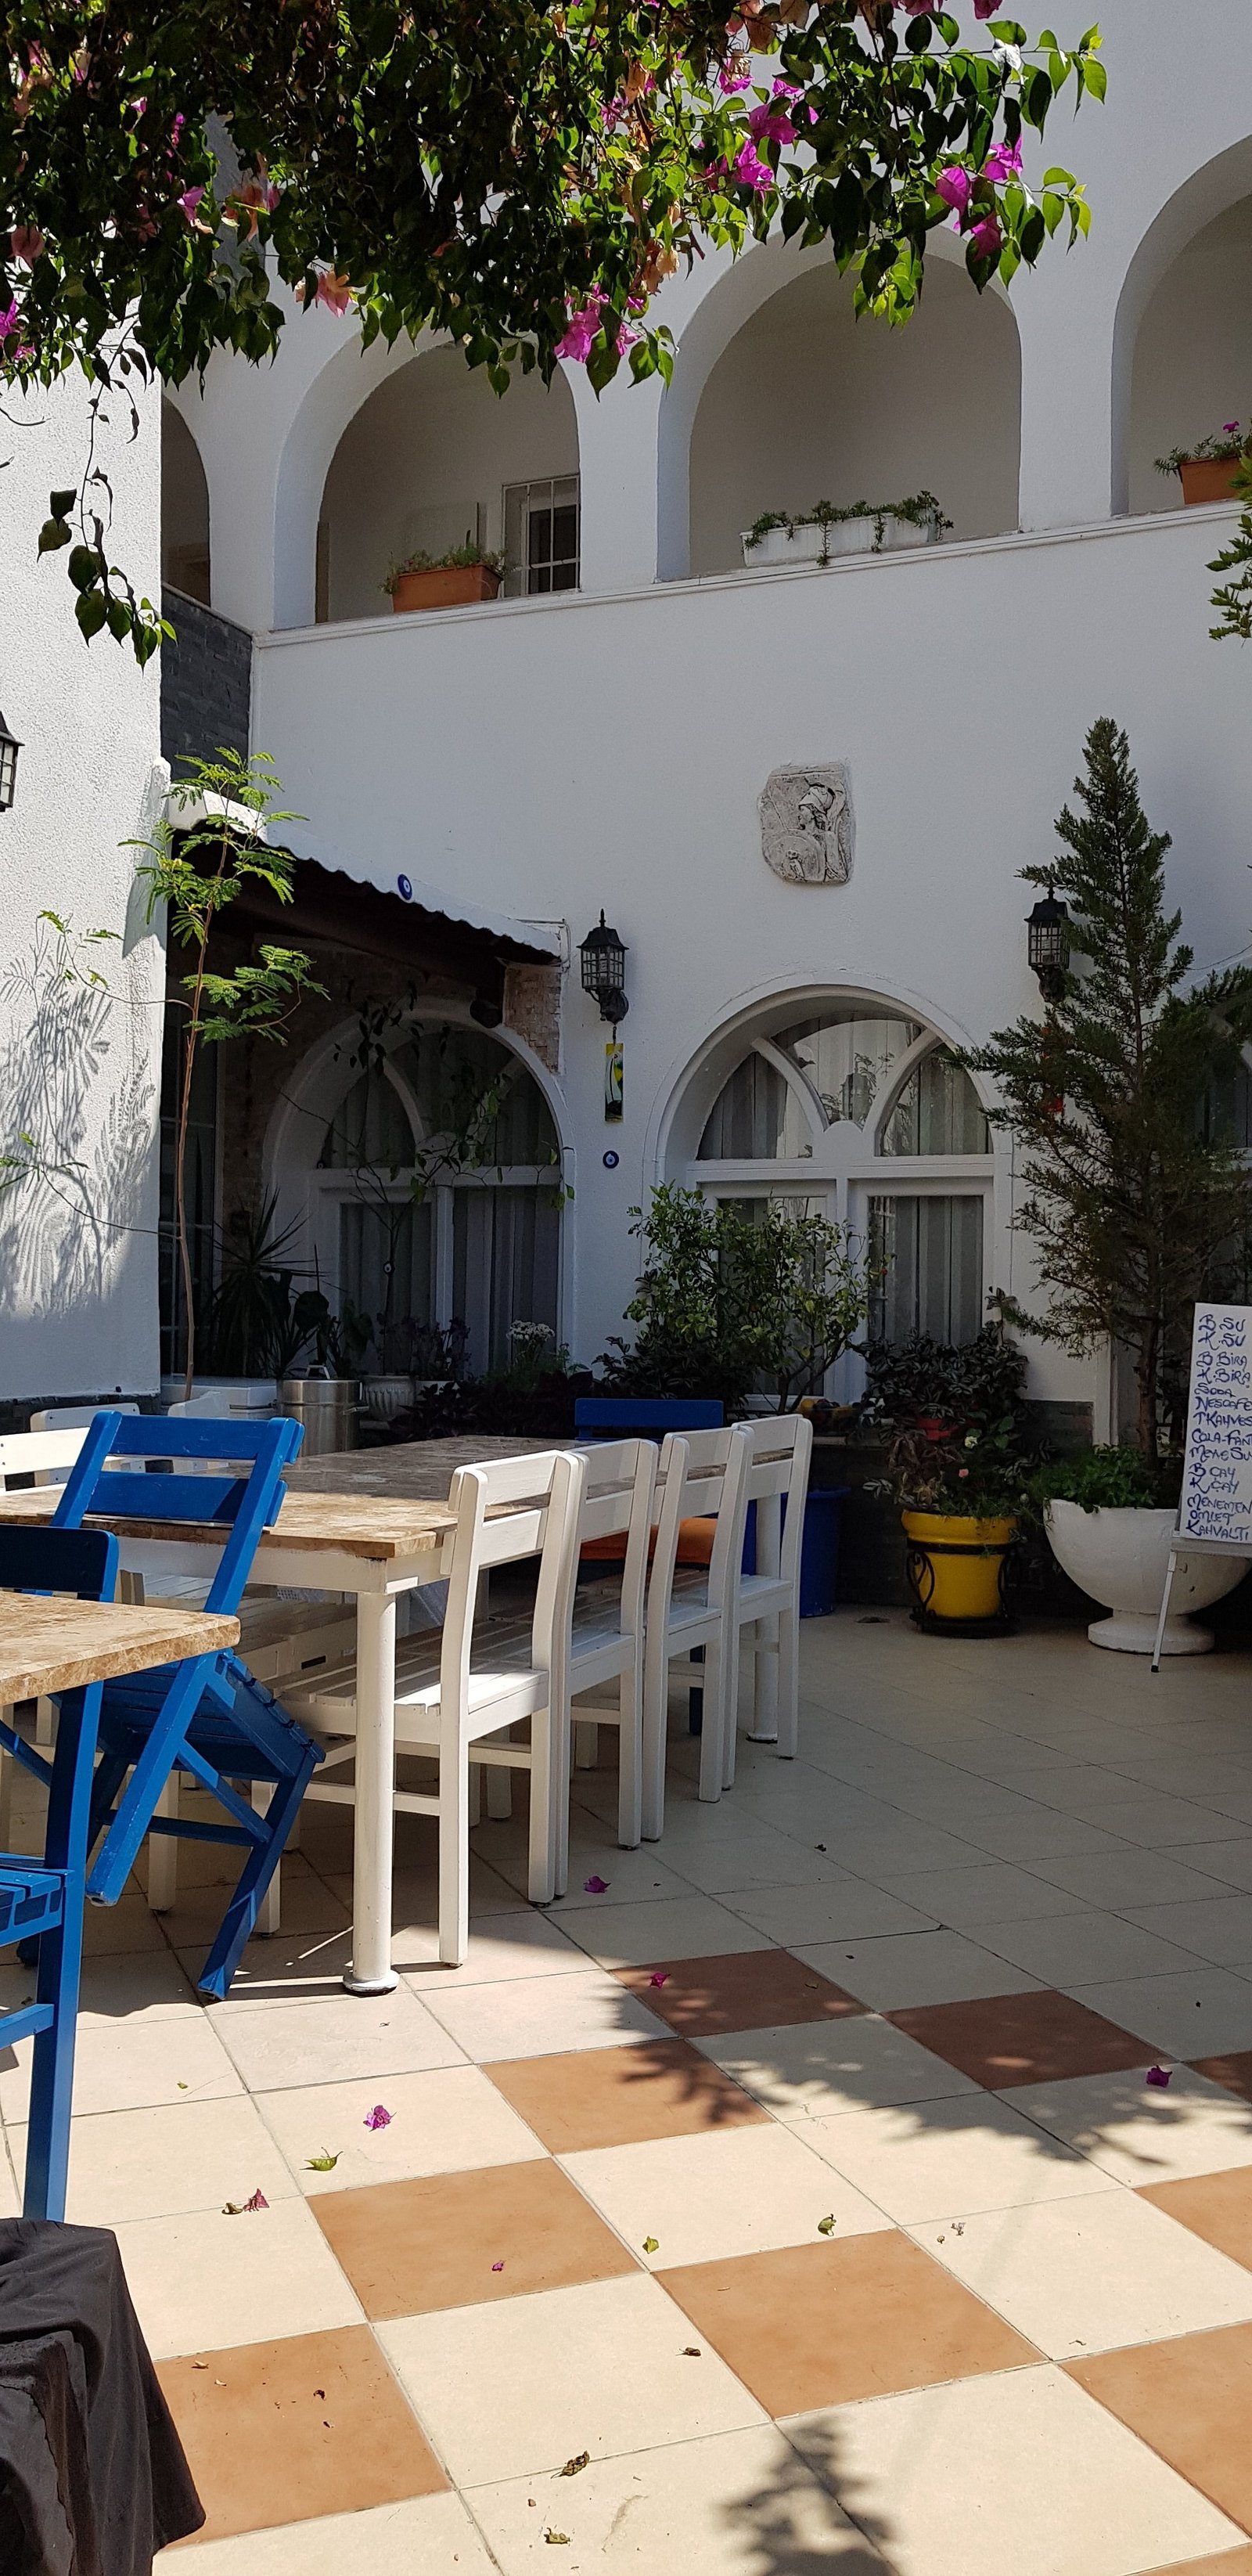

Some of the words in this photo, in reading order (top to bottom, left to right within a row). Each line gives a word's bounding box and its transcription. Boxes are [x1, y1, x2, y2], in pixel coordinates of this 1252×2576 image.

[1198, 1314, 1216, 1331] B
[1219, 1317, 1246, 1331] SU
[1196, 1351, 1213, 1367] B
[1194, 1382, 1236, 1397] SODA
[1188, 1462, 1206, 1477] B
[1189, 1476, 1211, 1493] K
[1187, 1493, 1252, 1514] MENEMEN
[1190, 1510, 1236, 1526] OMLET
[1185, 1519, 1250, 1541] KAHVALTI
